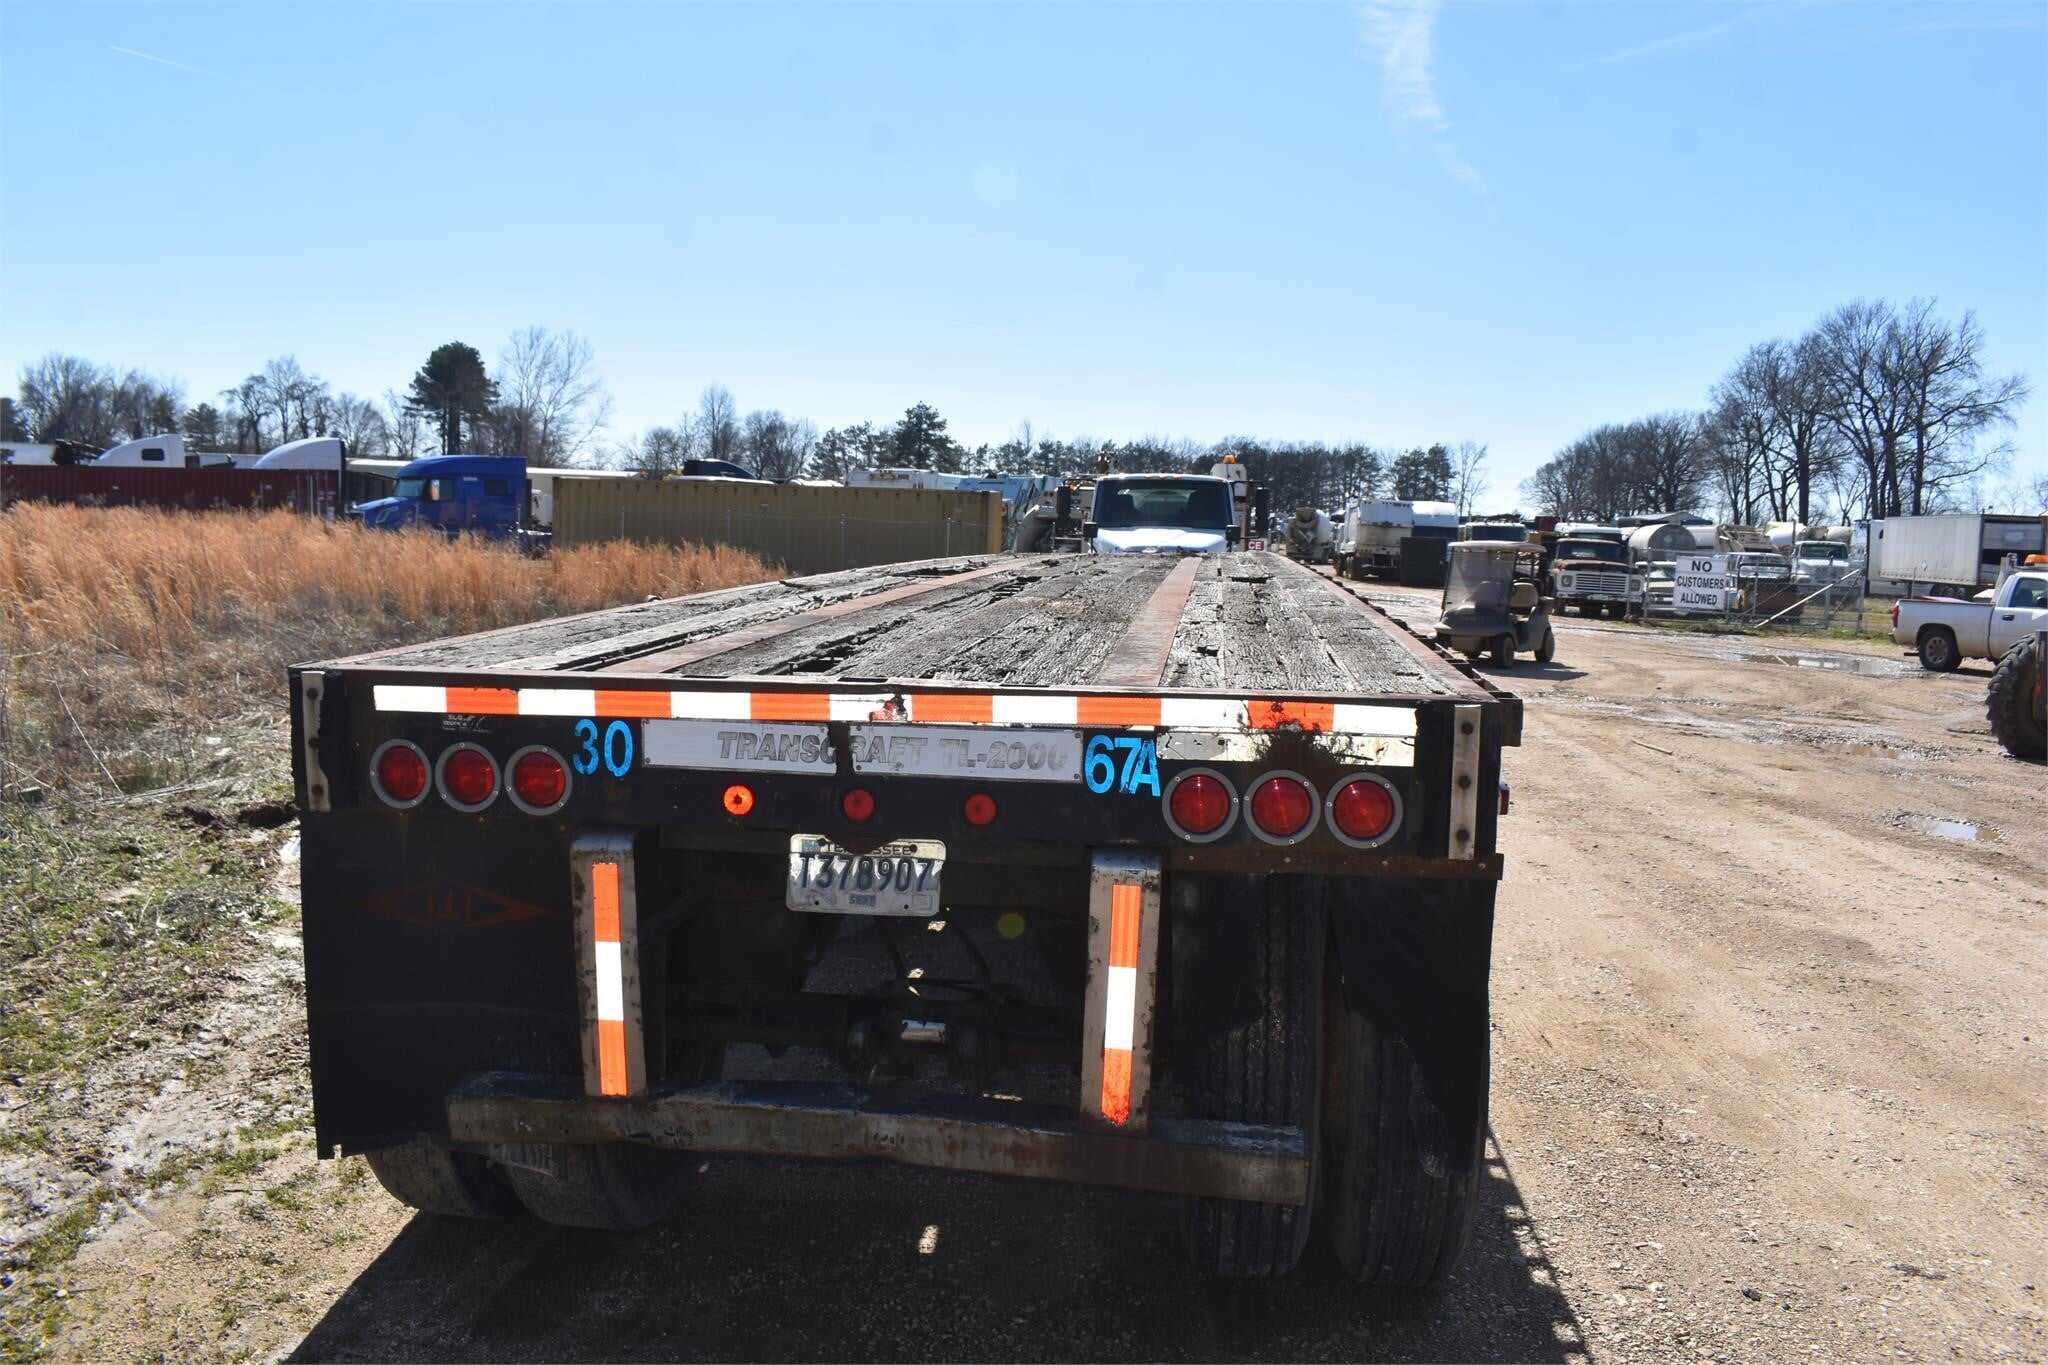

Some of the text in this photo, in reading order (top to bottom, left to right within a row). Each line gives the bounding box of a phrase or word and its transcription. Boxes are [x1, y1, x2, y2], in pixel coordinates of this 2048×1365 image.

[1691, 560, 1713, 572] NO
[1677, 576, 1724, 589] CUSTOMERS
[1681, 592, 1718, 606] ALLOWED
[573, 719, 633, 777] 30
[1084, 735, 1161, 797] 67A
